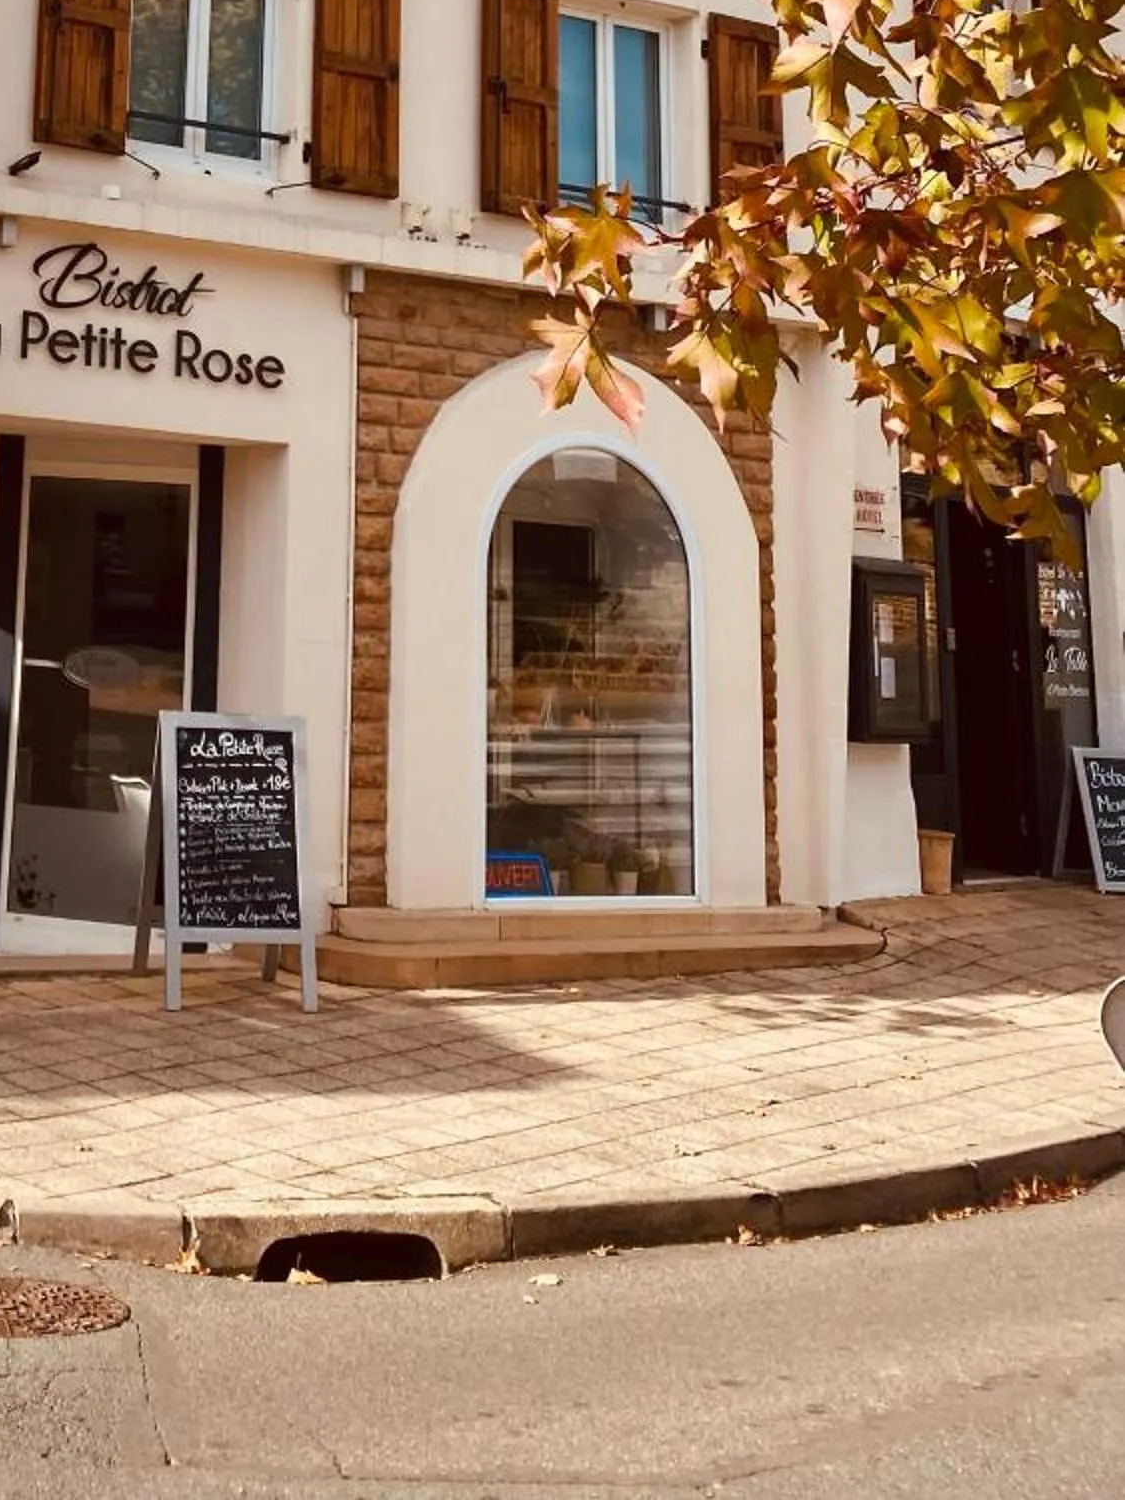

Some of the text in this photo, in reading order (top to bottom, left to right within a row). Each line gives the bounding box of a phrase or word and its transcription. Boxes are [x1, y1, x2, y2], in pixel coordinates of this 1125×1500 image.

[32, 243, 217, 317] Bistrot
[20, 309, 159, 373] Petite
[173, 328, 286, 389] Rose
